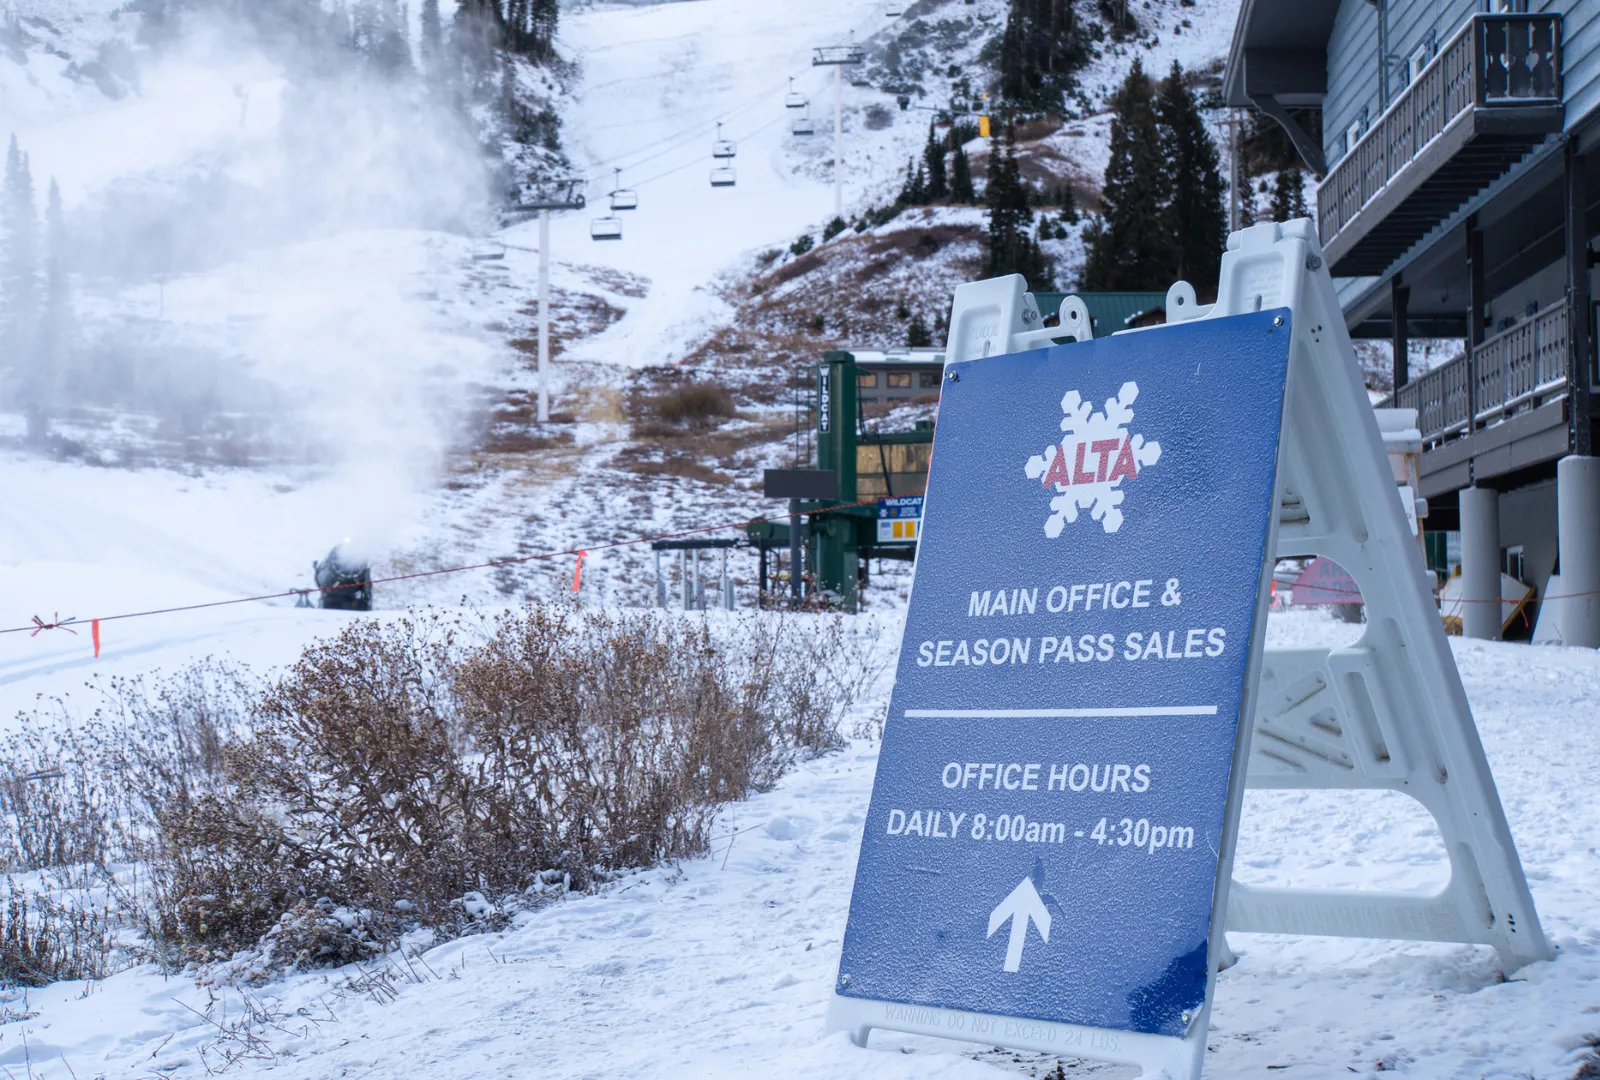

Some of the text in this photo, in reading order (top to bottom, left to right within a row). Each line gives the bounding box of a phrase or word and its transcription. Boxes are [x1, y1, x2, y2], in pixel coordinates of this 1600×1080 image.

[820, 367, 829, 431] WILDCAT
[1042, 435, 1138, 488] ALTA
[885, 497, 923, 507] WILDCAT
[1310, 581, 1361, 598] CLOS
[1320, 561, 1351, 578] AR
[968, 577, 1182, 617] MAIN OFFICE &
[917, 627, 1227, 667] SEASON PASS SALES
[941, 762, 1151, 793] OFFICE HOURS
[886, 809, 966, 839] DAILY
[971, 812, 1066, 844] 8:00am
[1090, 817, 1195, 854] 4:30pm
[884, 1003, 941, 1027] WARNING
[947, 1012, 964, 1029] DO
[971, 1016, 998, 1034] NOT
[1004, 1019, 1056, 1043] EXCEED
[1065, 1028, 1081, 1046] 24
